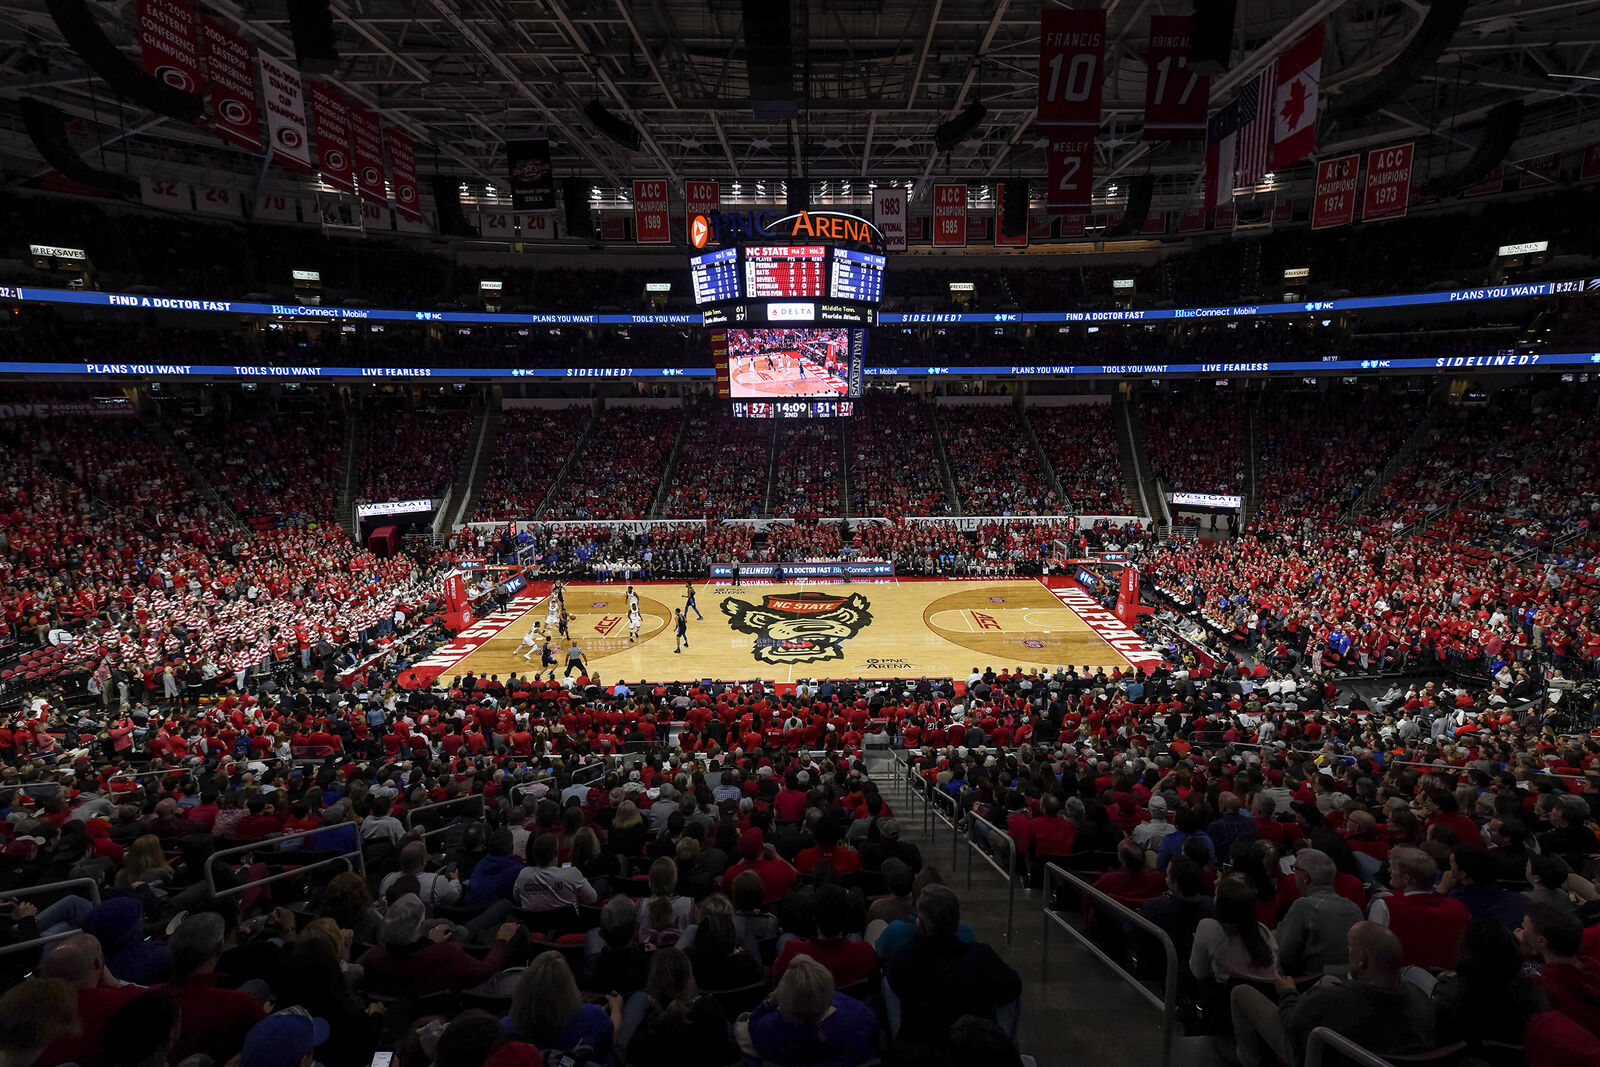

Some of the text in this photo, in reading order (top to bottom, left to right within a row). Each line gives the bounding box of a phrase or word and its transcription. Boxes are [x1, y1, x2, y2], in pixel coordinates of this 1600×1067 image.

[148, 4, 188, 36] EASTERN
[142, 16, 196, 54] CONFERENCE
[204, 25, 250, 59] 2005-2006
[1046, 32, 1100, 46] FRANCIS
[143, 32, 197, 68] CHAMPIONS
[212, 43, 246, 70] EASTERN
[208, 56, 254, 86] CONFERENCE
[1047, 53, 1097, 102] 10
[210, 72, 255, 101] CHAMPIONS
[269, 76, 296, 98] STANLEY
[1153, 56, 1198, 104] 17
[279, 94, 291, 106] CUP
[268, 100, 304, 127] CHAMPIONS
[313, 101, 347, 124] SOUTHEAST
[319, 115, 345, 136] DIVISION
[1052, 142, 1088, 152] WESLEY
[1378, 150, 1404, 170] ACC
[1060, 156, 1080, 190] 2
[1326, 162, 1350, 180] ACC
[1368, 168, 1408, 187] CHAMPIONS
[152, 182, 176, 198] 32
[642, 184, 660, 198] ACC
[693, 186, 712, 199] ACC
[1318, 178, 1354, 196] CHAMPIONS
[942, 189, 960, 202] ACC
[1376, 187, 1398, 204] 1973
[636, 201, 668, 212] CHAMPIONS
[688, 202, 718, 213] CHAMPIONS
[880, 199, 900, 215] 1983
[936, 206, 965, 216] CHAMPIONS
[1324, 196, 1344, 212] 1974
[489, 216, 508, 228] 24
[528, 216, 545, 230] 20
[644, 215, 660, 229] 1989
[715, 210, 870, 242] PNC ARENA
[942, 220, 958, 234] 1985
[32, 247, 84, 258] #REXSAVES
[746, 248, 788, 256] NC STATE
[1450, 286, 1545, 301] PLANS YOU WANT
[1556, 282, 1573, 292] 9:32
[109, 295, 231, 312] FIND A DOCTOR FAST
[272, 305, 368, 318] BlueConnect Mobile
[903, 314, 962, 322] SIDELINED?
[1175, 307, 1257, 318] BlueConnect Mobile
[1202, 363, 1268, 372] LIVE FEARLESS
[1436, 354, 1540, 367] SIDELINED?
[87, 364, 191, 375] PLANS YOU WANT
[234, 366, 322, 376] TOOLS YOU WANT
[362, 368, 431, 377] LIVE FEARLESS
[567, 369, 633, 377] SIDELINED?
[1012, 366, 1036, 374] PLANS
[1143, 365, 1168, 373] WANT
[752, 403, 765, 413] 57
[776, 403, 806, 412] 14:09
[817, 403, 829, 412] 51
[932, 519, 976, 529] STATE
[773, 601, 833, 610] NC STATE
[594, 616, 622, 636] ACC
[973, 611, 1002, 630] ACC
[1049, 587, 1163, 662] WOLFPACK
[412, 596, 545, 668] NC STATE
